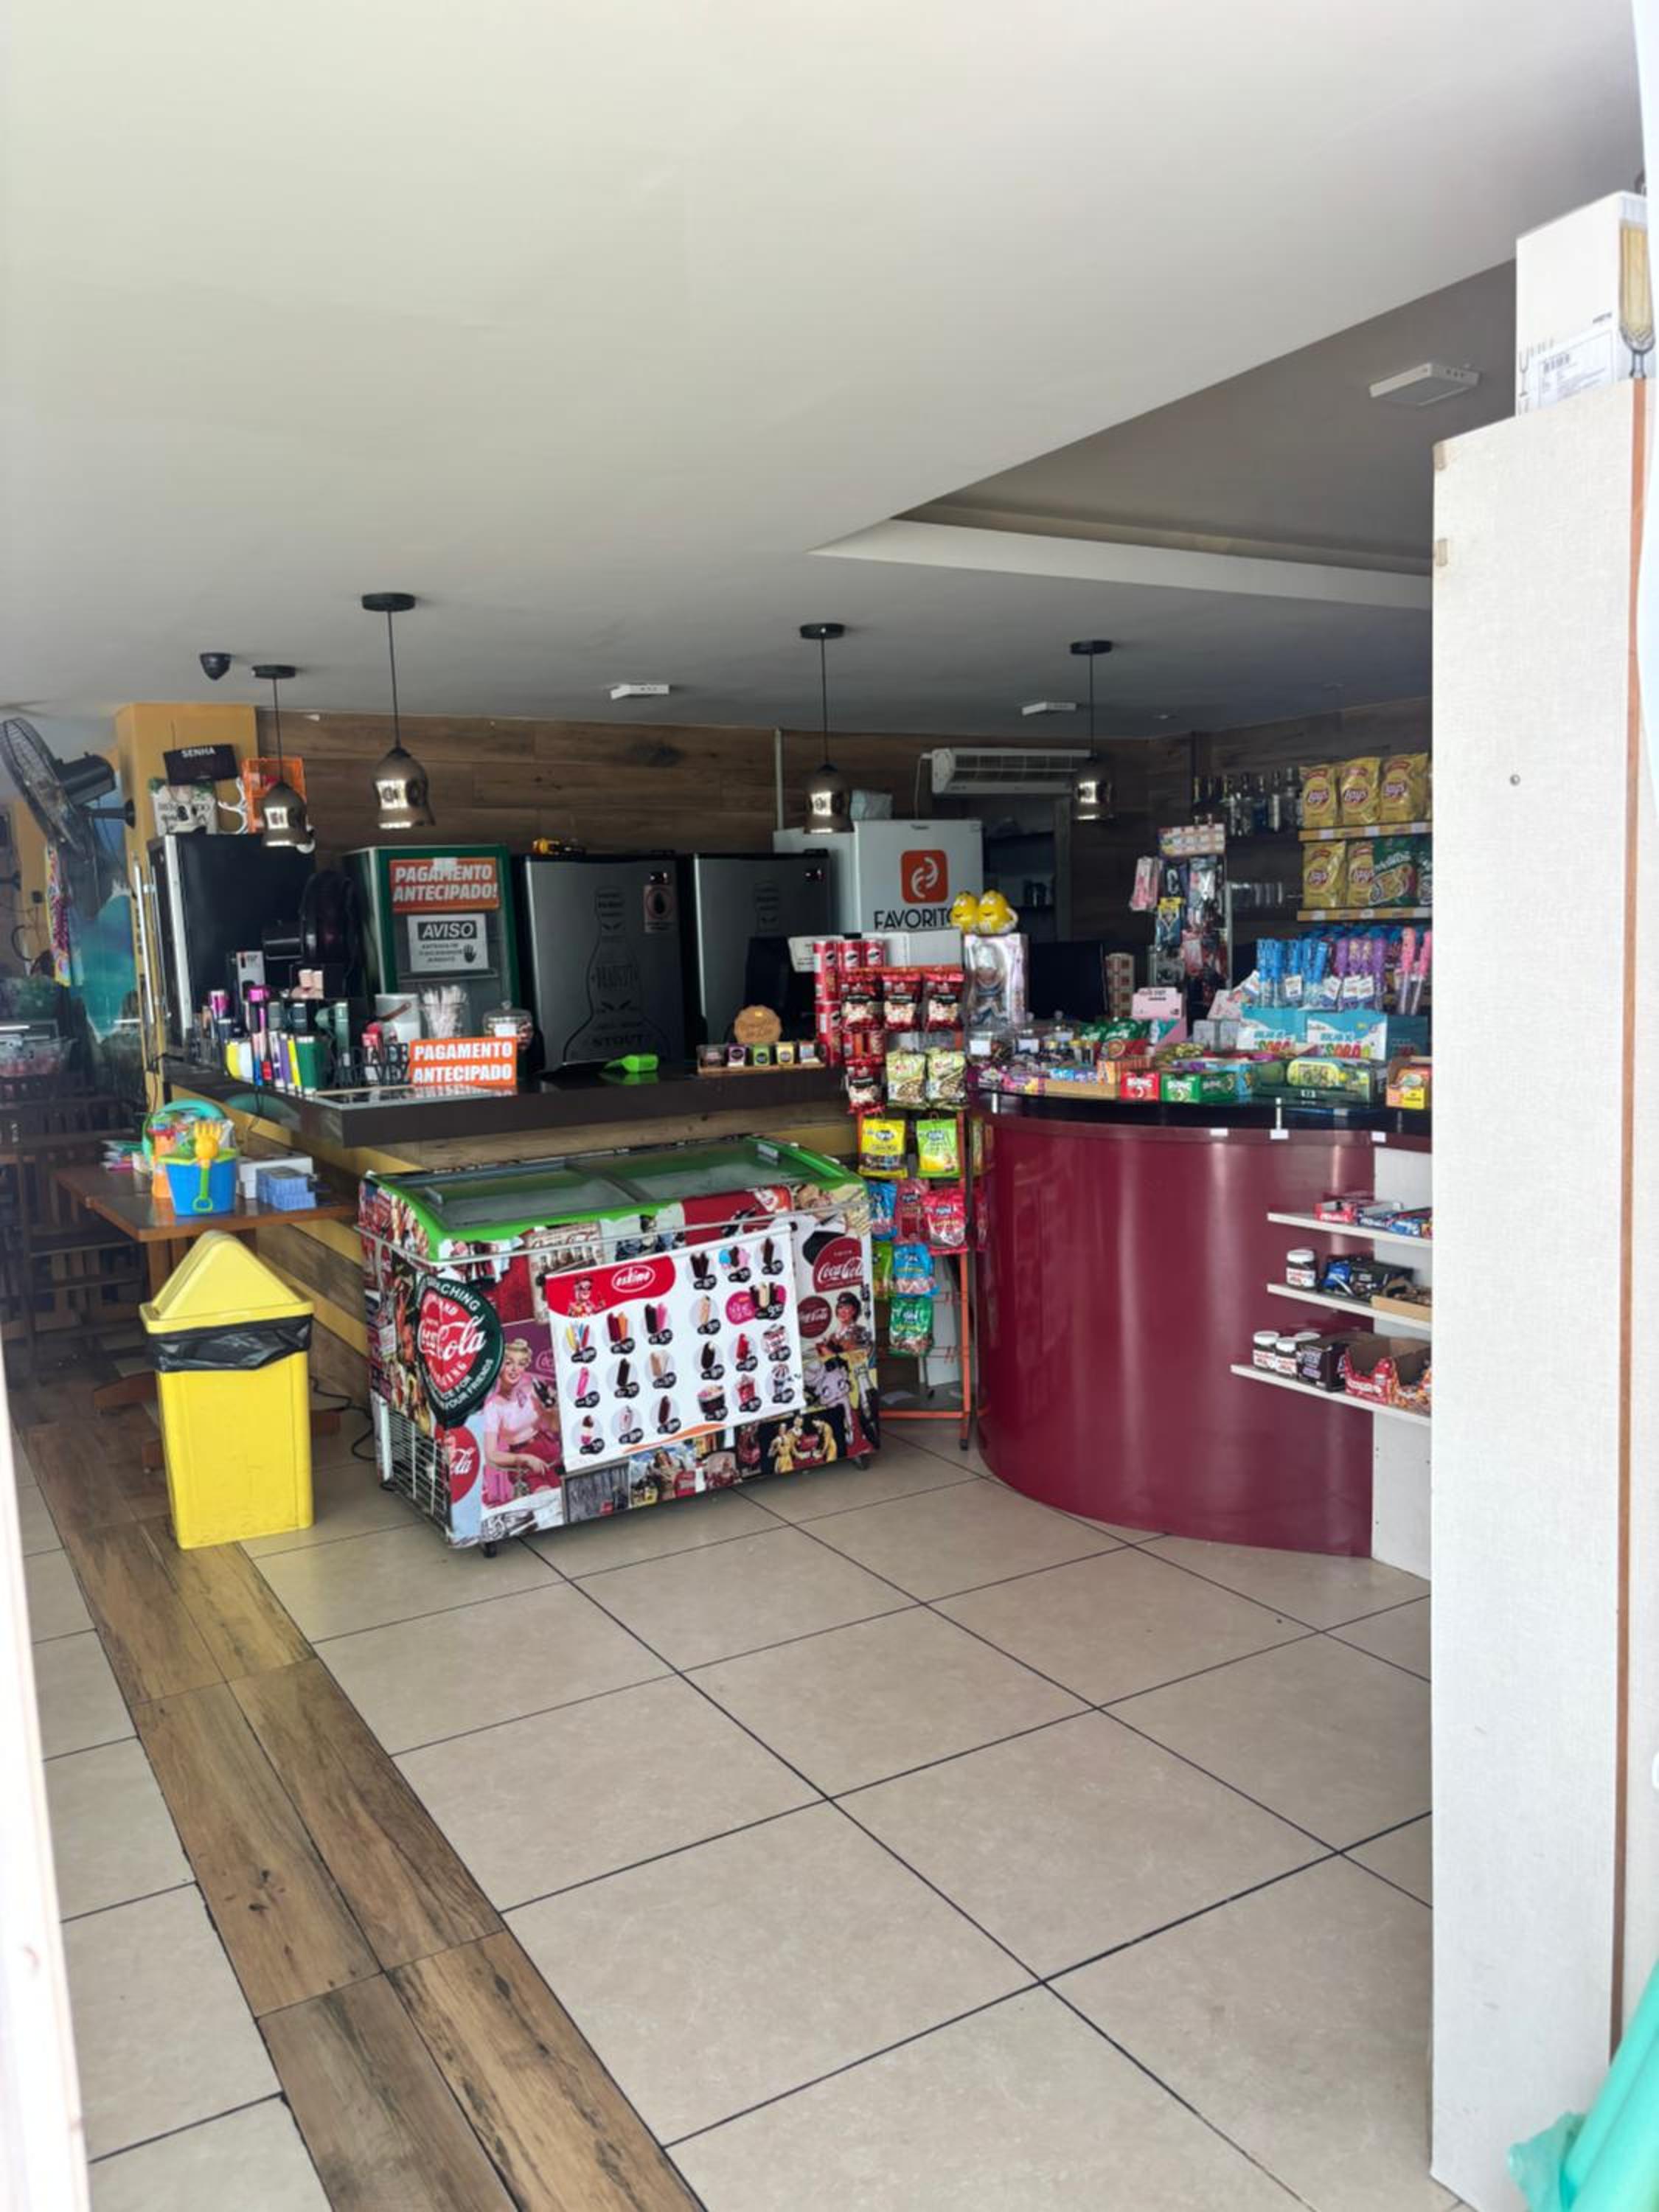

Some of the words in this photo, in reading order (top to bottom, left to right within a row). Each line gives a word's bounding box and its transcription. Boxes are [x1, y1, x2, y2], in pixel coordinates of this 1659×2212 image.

[181, 747, 216, 758] SENHA
[395, 864, 493, 883] PAGAMENTO
[392, 883, 498, 902] ANTECIPADO!
[422, 922, 474, 939] AVISO
[414, 1041, 512, 1062] PAGAMENTO
[412, 1063, 512, 1085] ANTECIPADO
